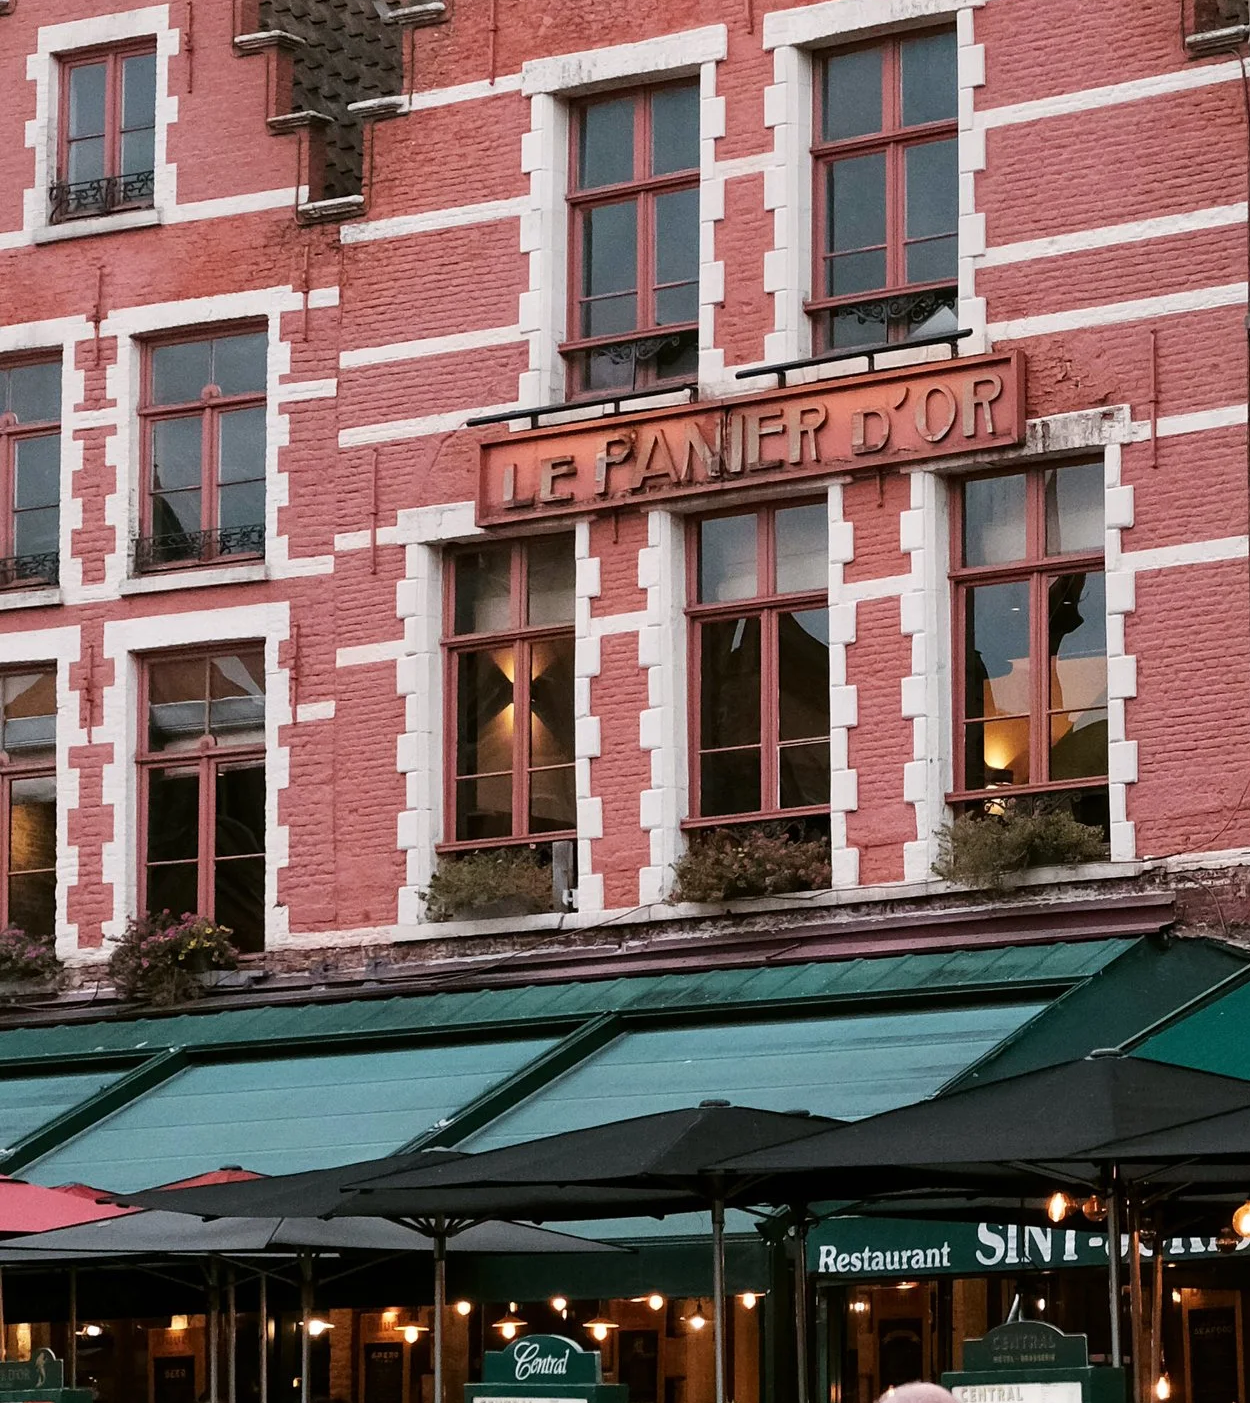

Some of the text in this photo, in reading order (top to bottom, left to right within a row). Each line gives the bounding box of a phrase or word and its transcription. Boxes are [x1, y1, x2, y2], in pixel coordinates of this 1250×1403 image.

[502, 372, 1004, 509] LE PANIER D'OR
[817, 1240, 951, 1274] Restaurant
[513, 1341, 569, 1381] Central
[961, 1386, 1024, 1403] CENTRAL
